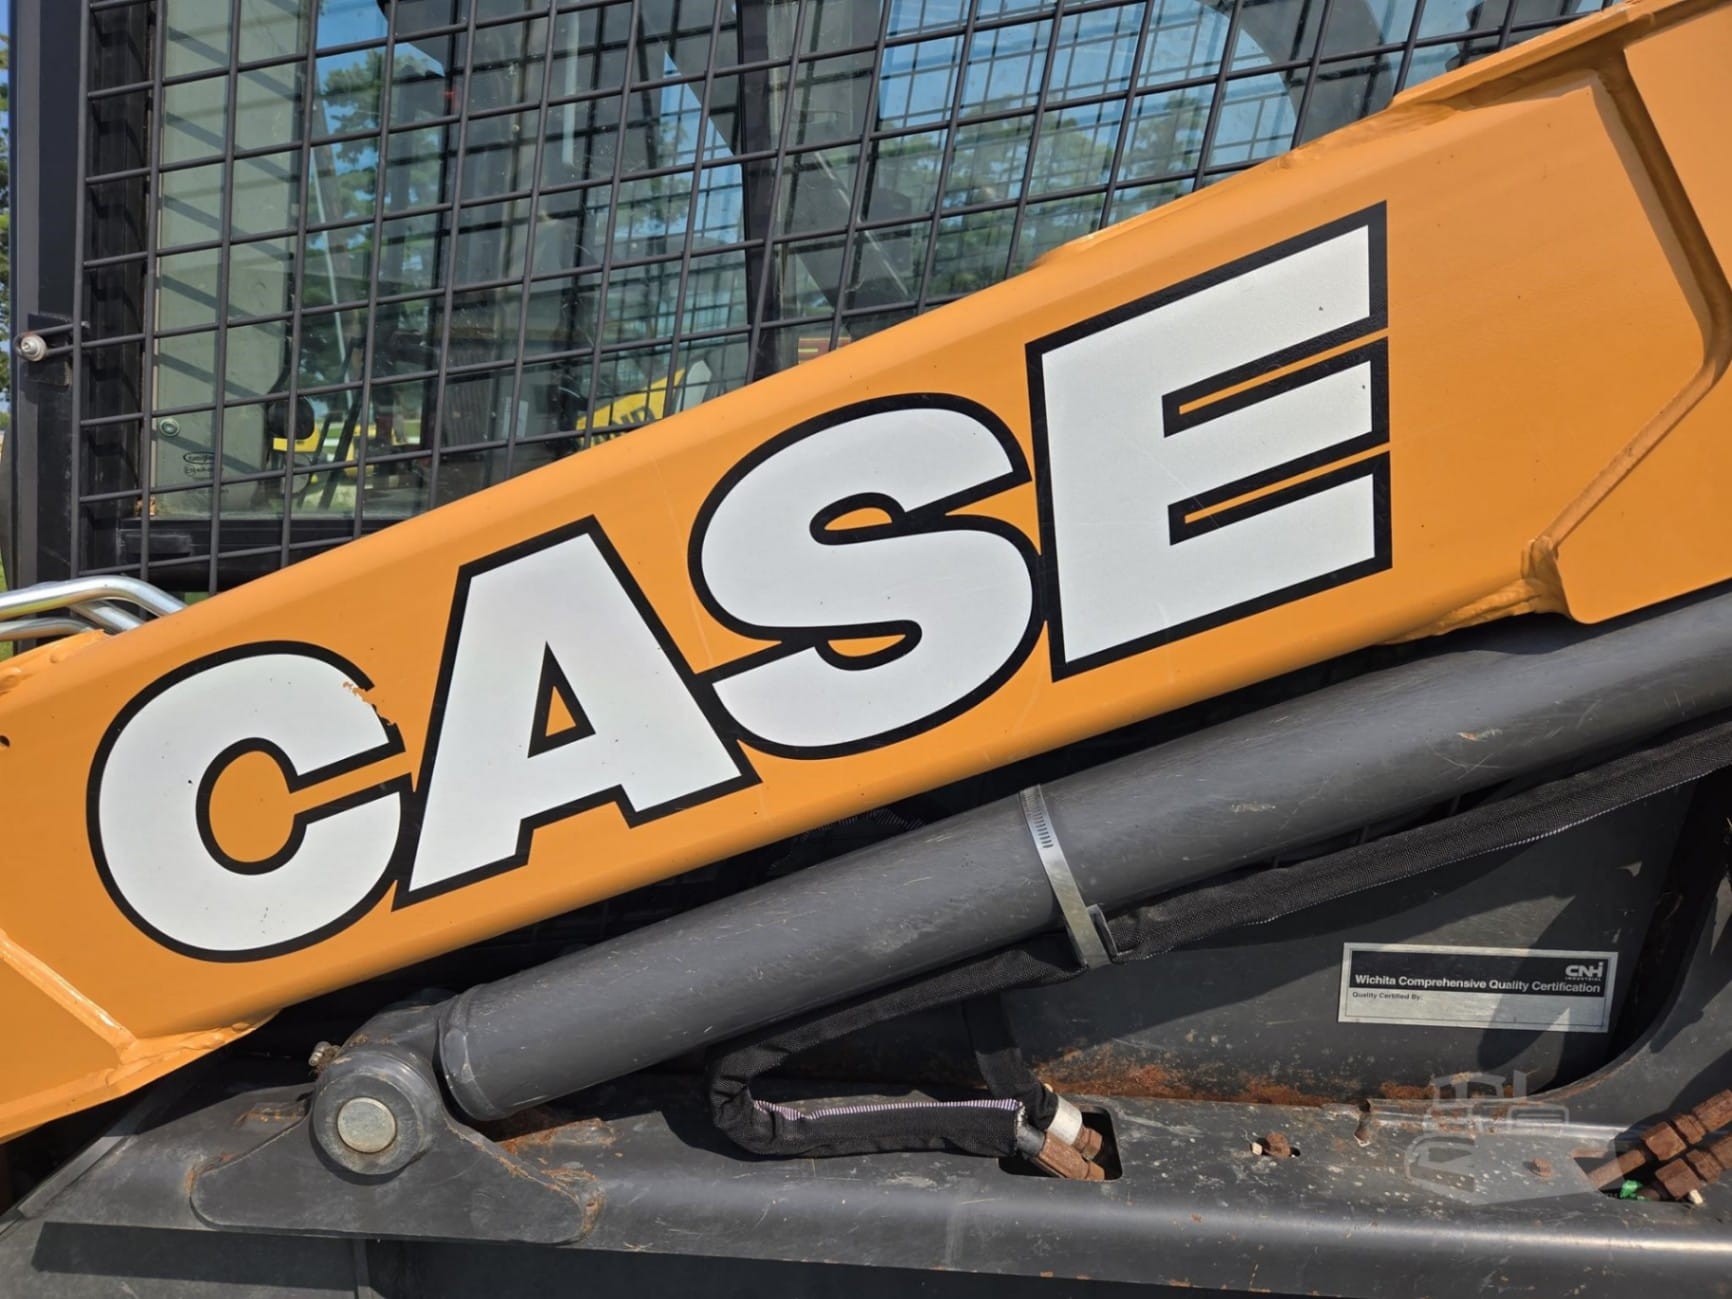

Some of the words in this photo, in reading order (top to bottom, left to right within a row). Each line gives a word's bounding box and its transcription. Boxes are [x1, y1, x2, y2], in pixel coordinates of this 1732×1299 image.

[87, 201, 1391, 961] CASE
[1355, 974, 1396, 985] Wichita
[1398, 976, 1487, 989] Comprehensive
[1489, 979, 1529, 992] Quality
[1532, 981, 1601, 993] Certification
[1352, 991, 1377, 999] Quality
[1379, 992, 1409, 1000] Certified
